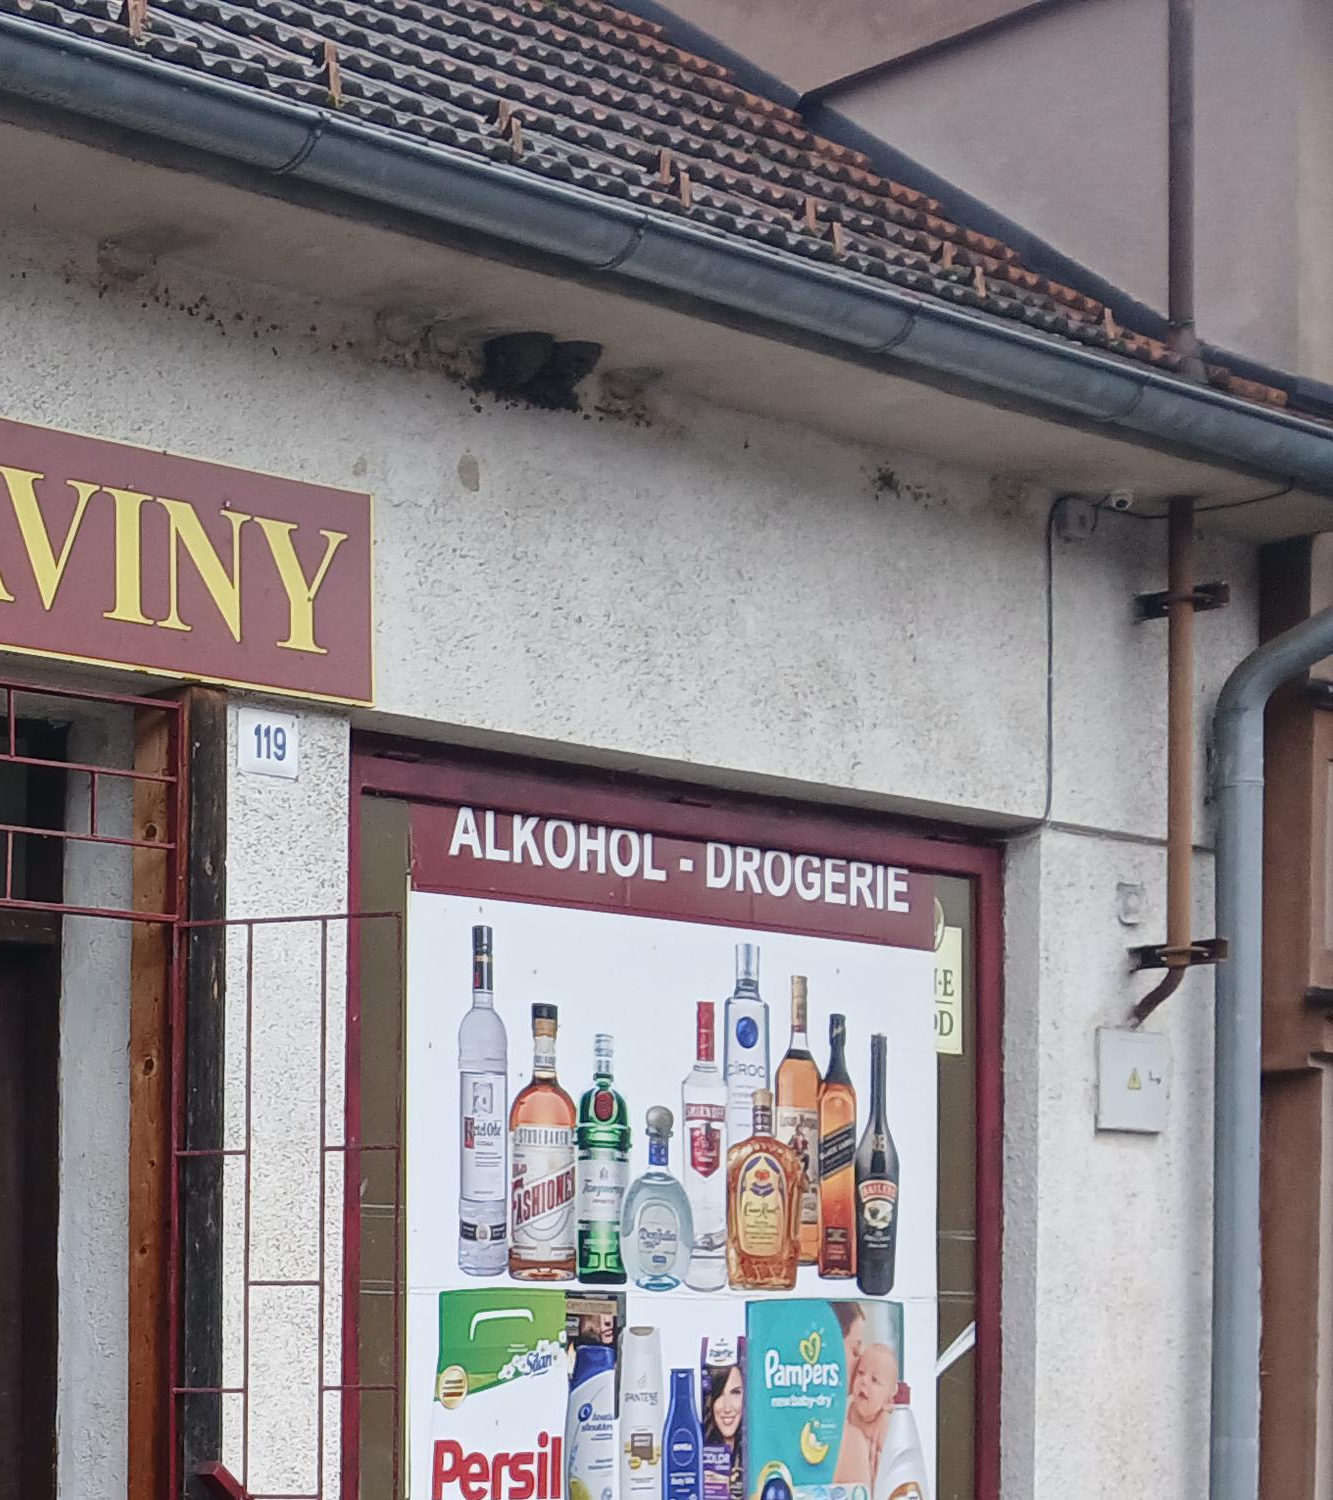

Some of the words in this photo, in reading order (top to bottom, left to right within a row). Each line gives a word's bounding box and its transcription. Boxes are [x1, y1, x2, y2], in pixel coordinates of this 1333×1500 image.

[254, 723, 287, 762] 119
[448, 806, 667, 882] ALKOHOL
[679, 858, 694, 872] -
[705, 841, 910, 914] DROGERIE
[764, 1349, 839, 1393] Pampers
